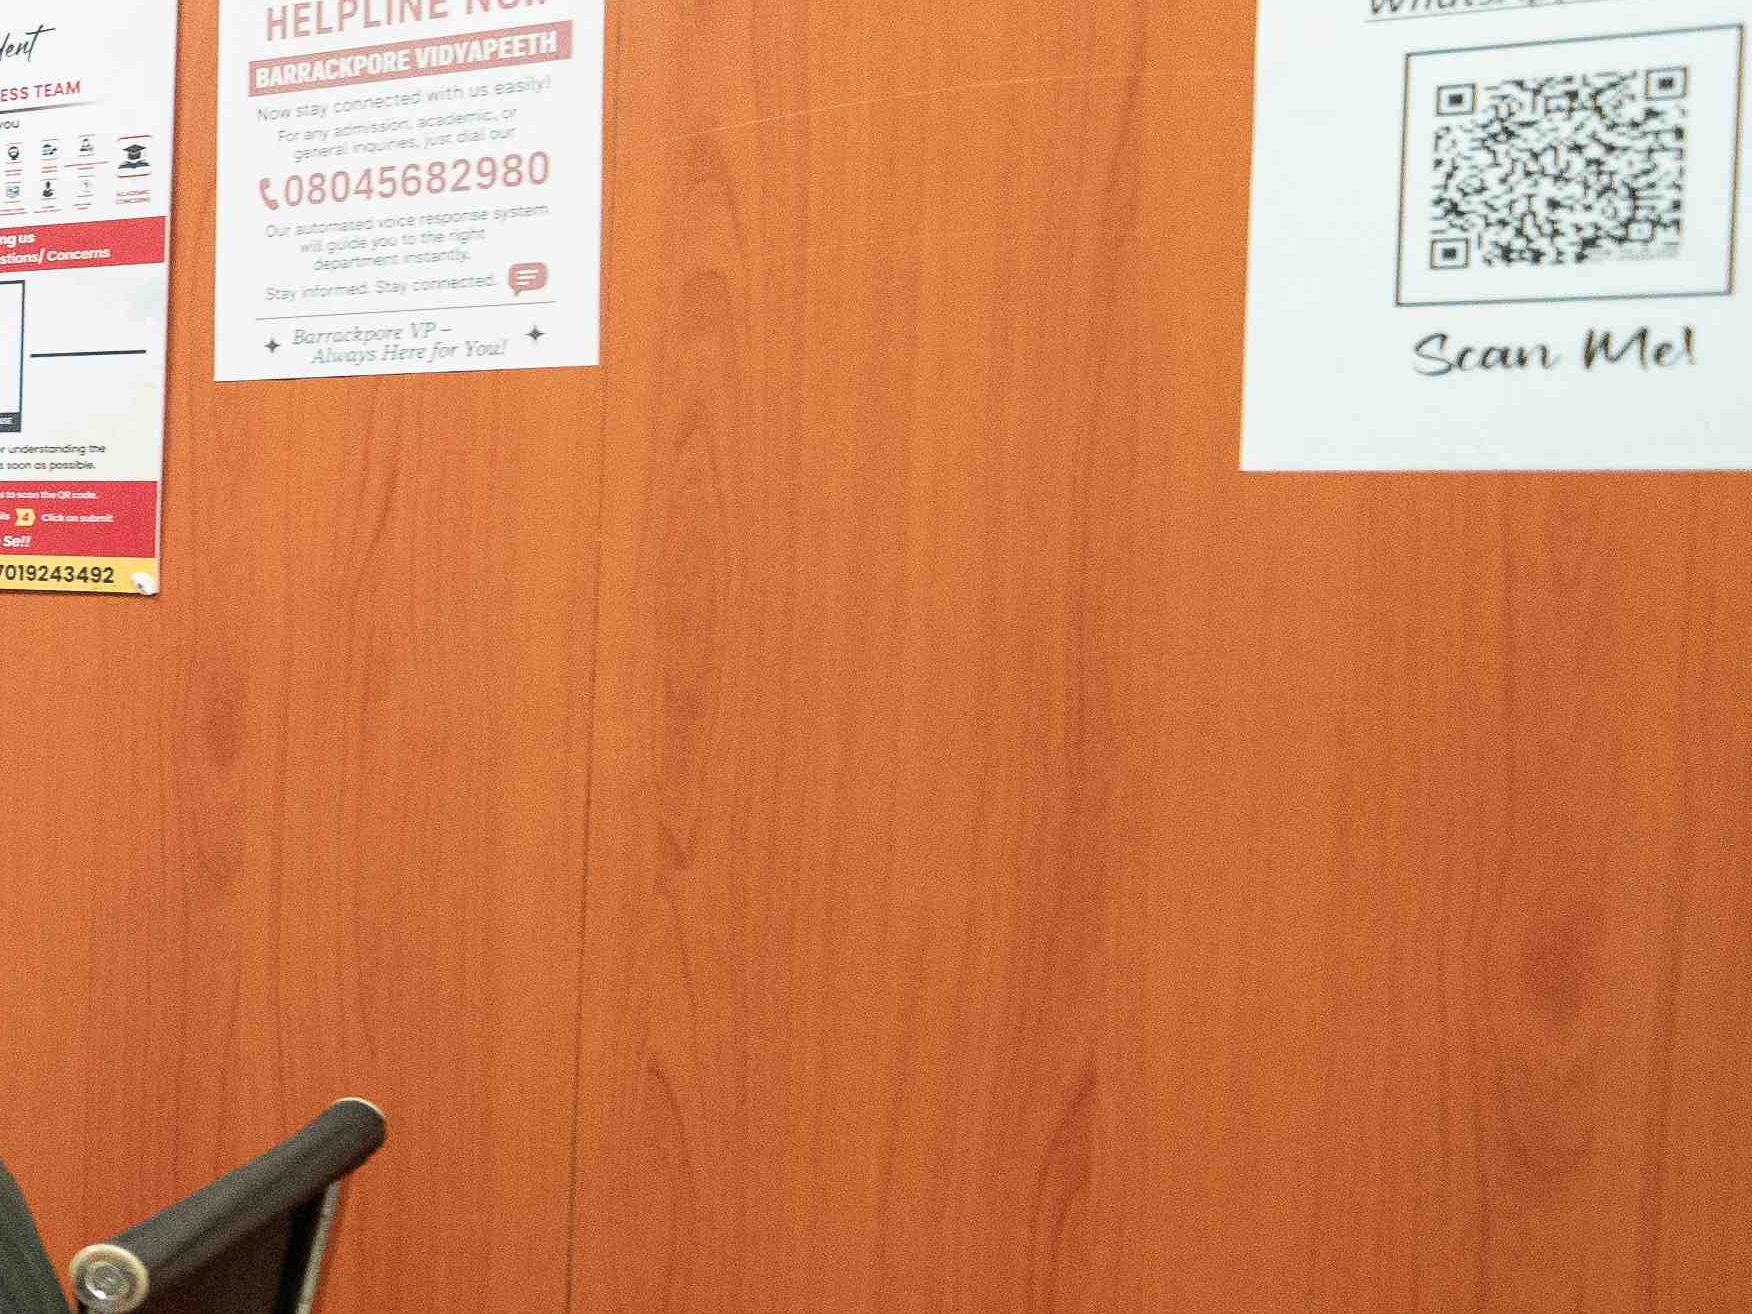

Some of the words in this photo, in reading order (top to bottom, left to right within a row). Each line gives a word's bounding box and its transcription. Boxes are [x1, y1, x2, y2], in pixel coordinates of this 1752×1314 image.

[255, 51, 409, 89] BARRACKPORE
[414, 29, 557, 71] VIDYAPEETH
[34, 81, 81, 98] TEAM
[284, 150, 550, 207] 08045682980
[18, 232, 35, 245] us
[46, 247, 110, 262] Concerns
[293, 325, 403, 347] Barrackpore
[410, 322, 437, 340] VP
[311, 345, 377, 365] Always
[382, 342, 427, 361] Here
[430, 341, 458, 362] for
[463, 338, 507, 358] You!
[1413, 330, 1560, 377] Scan
[1582, 325, 1699, 372] Me!
